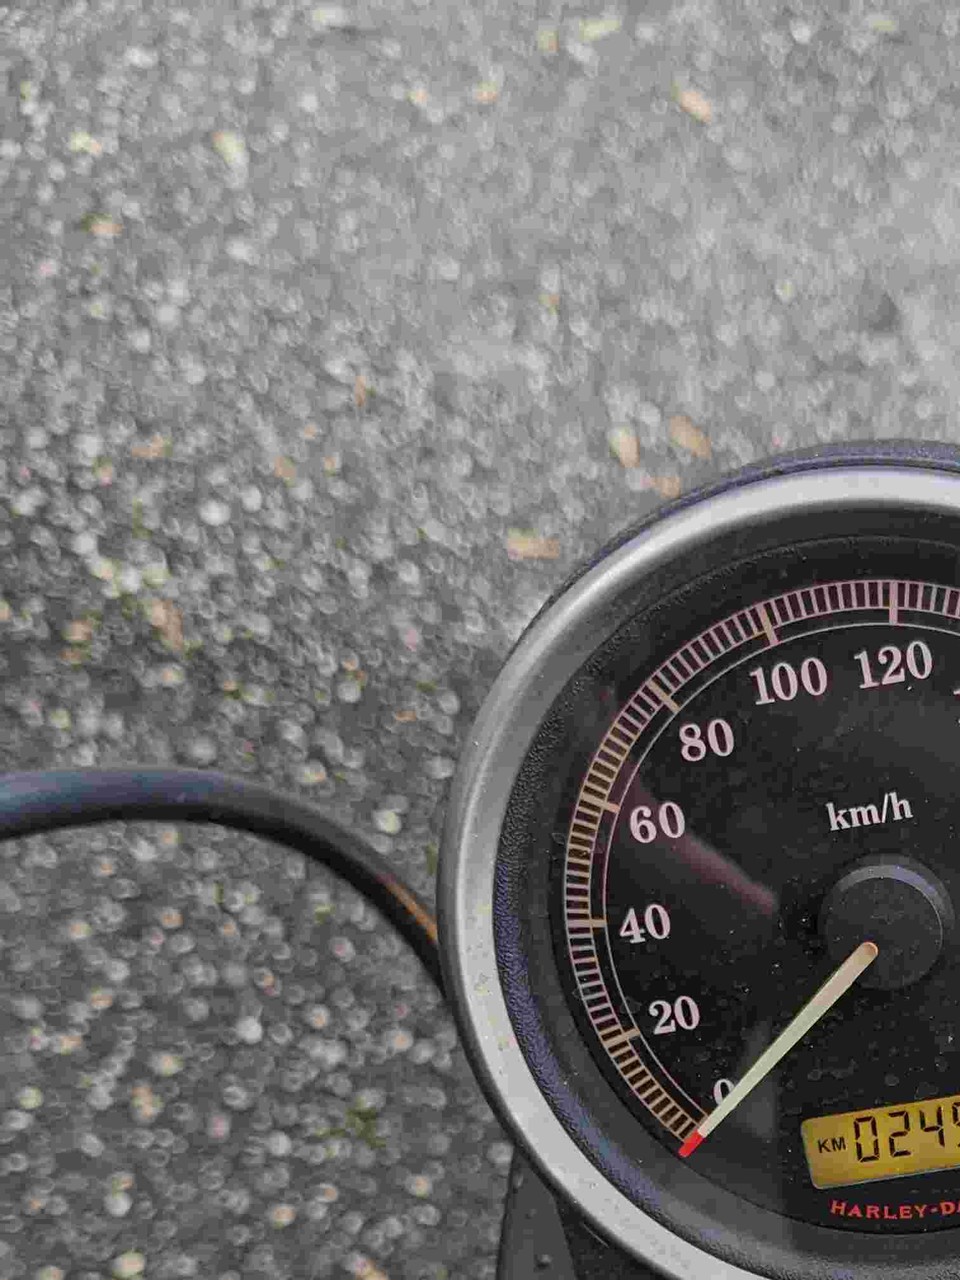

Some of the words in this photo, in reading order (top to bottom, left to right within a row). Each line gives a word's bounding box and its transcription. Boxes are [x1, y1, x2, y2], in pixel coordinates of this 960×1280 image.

[750, 657, 828, 705] 100
[854, 641, 932, 689] 120
[679, 719, 734, 761] 80
[629, 802, 685, 843] 60
[826, 791, 913, 831] km/h
[619, 904, 671, 944] 40
[649, 996, 700, 1035] 20
[817, 1136, 847, 1154] KM
